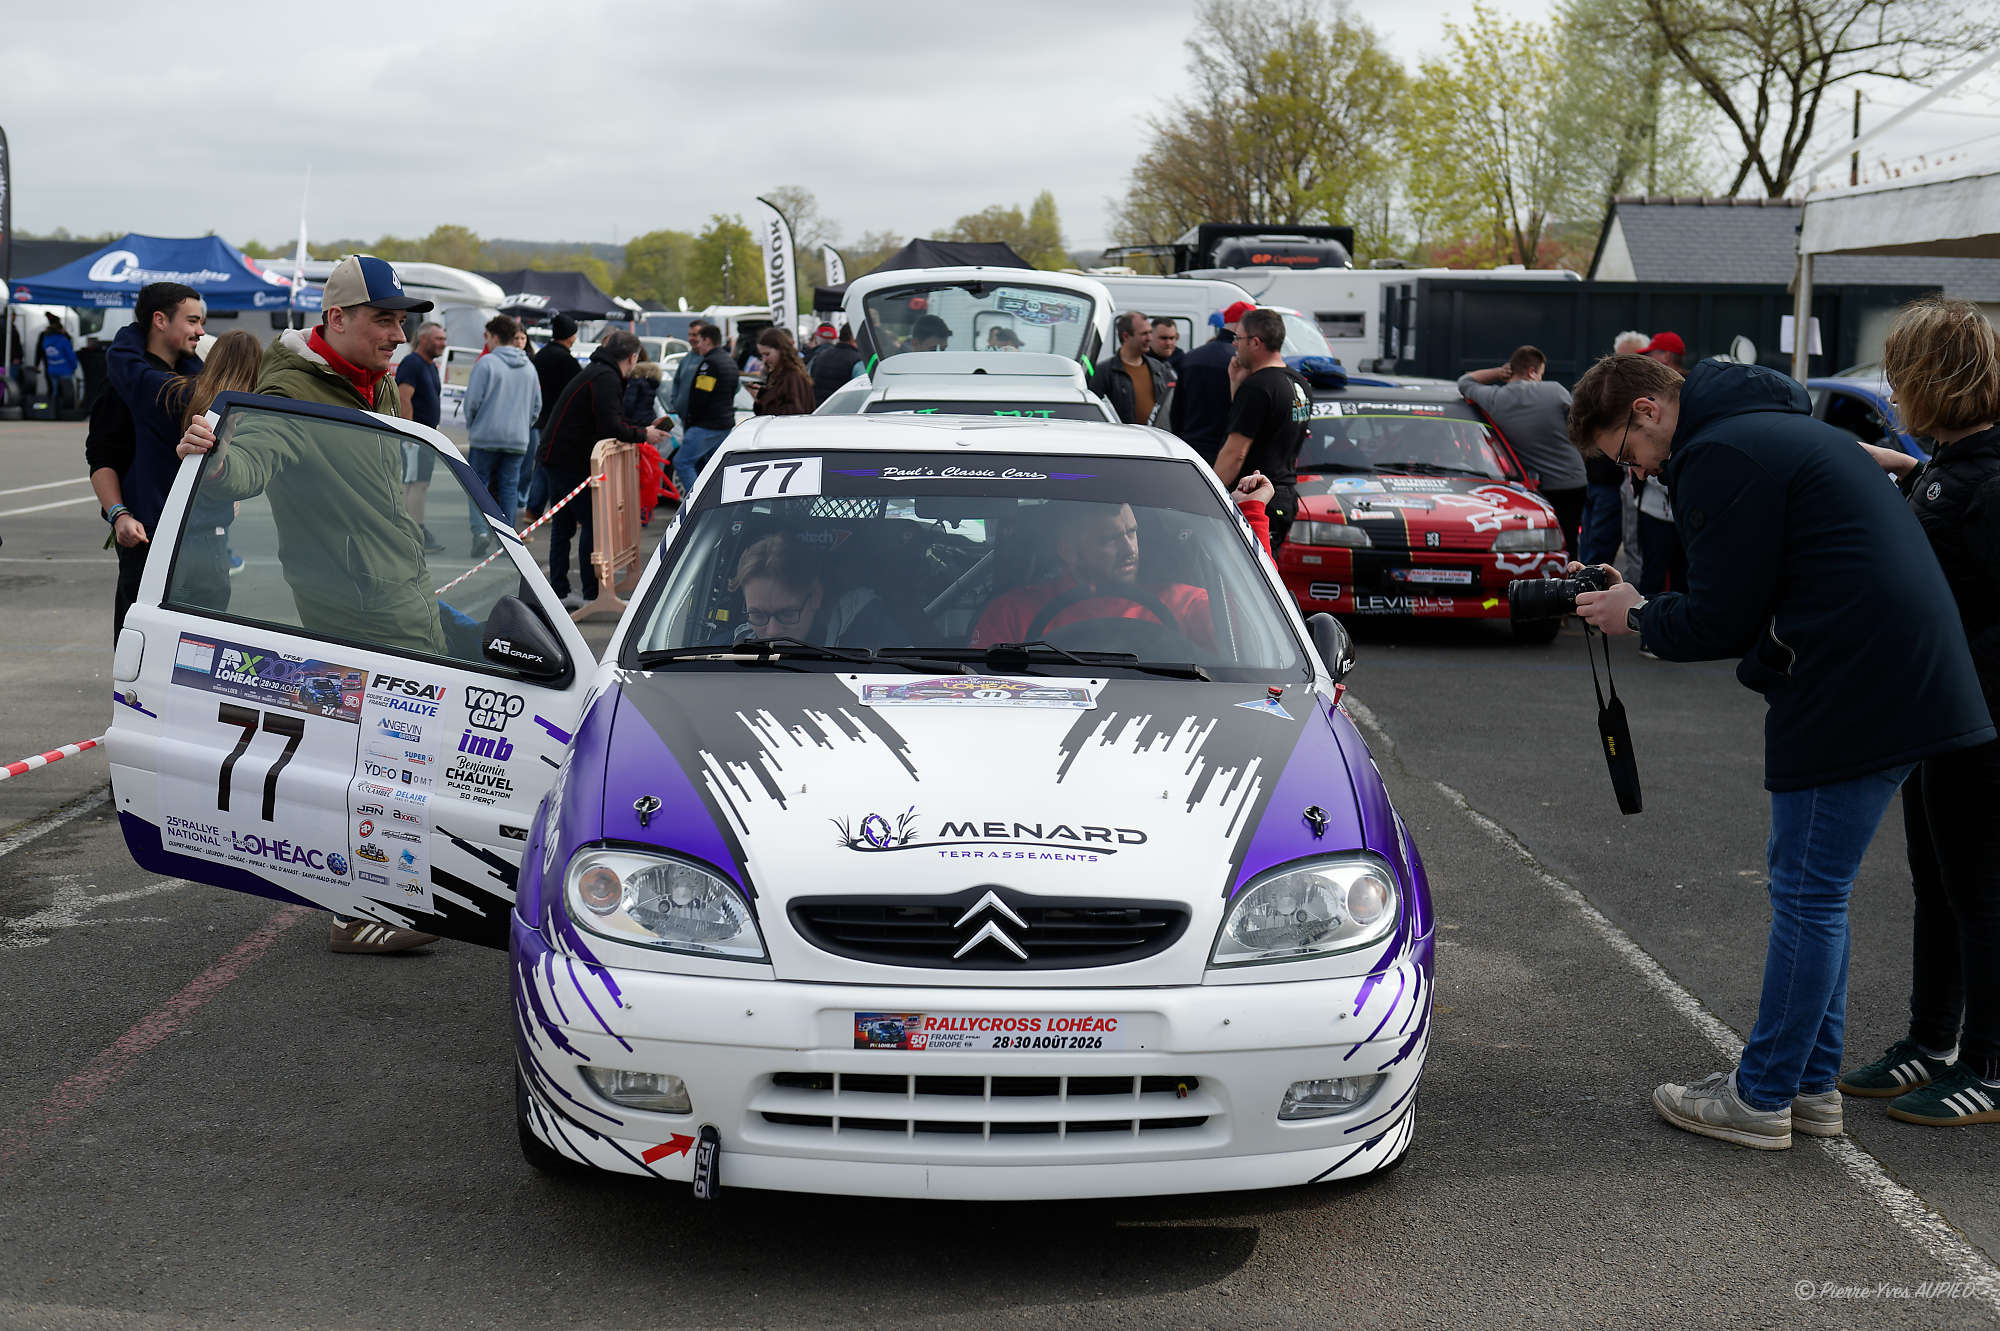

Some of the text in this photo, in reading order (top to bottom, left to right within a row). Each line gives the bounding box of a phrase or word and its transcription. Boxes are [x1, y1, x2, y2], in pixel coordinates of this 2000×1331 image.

[740, 461, 803, 497] 77
[882, 466, 1039, 479] Paul's Classic Cars
[215, 668, 261, 688] LOHEAC
[371, 674, 436, 700] FFSA
[389, 698, 439, 718] RALLYE
[466, 687, 524, 717] YOLO
[377, 717, 423, 736] ANGEVIN
[458, 729, 514, 762] imb
[217, 701, 306, 822] 77
[404, 750, 427, 761] SUPER
[456, 755, 505, 777] Benjamin
[446, 767, 514, 792] CHAUVEL
[395, 789, 428, 803] DELAIRE
[473, 786, 511, 799] ISOLATION
[167, 826, 221, 847] NATIONAL
[182, 818, 220, 836] RALLYE
[938, 821, 1148, 845] MENARD
[231, 830, 325, 870] LOHÉAC
[938, 850, 1098, 863] TERRASSEMENTS
[924, 1015, 1118, 1032] RALLYCROSS LOHÉAC
[910, 1033, 926, 1045] 50
[928, 1041, 962, 1049] EUROPE
[930, 1033, 965, 1041] FRANCE
[992, 1034, 1103, 1049] 28 30 AOÛT 2026
